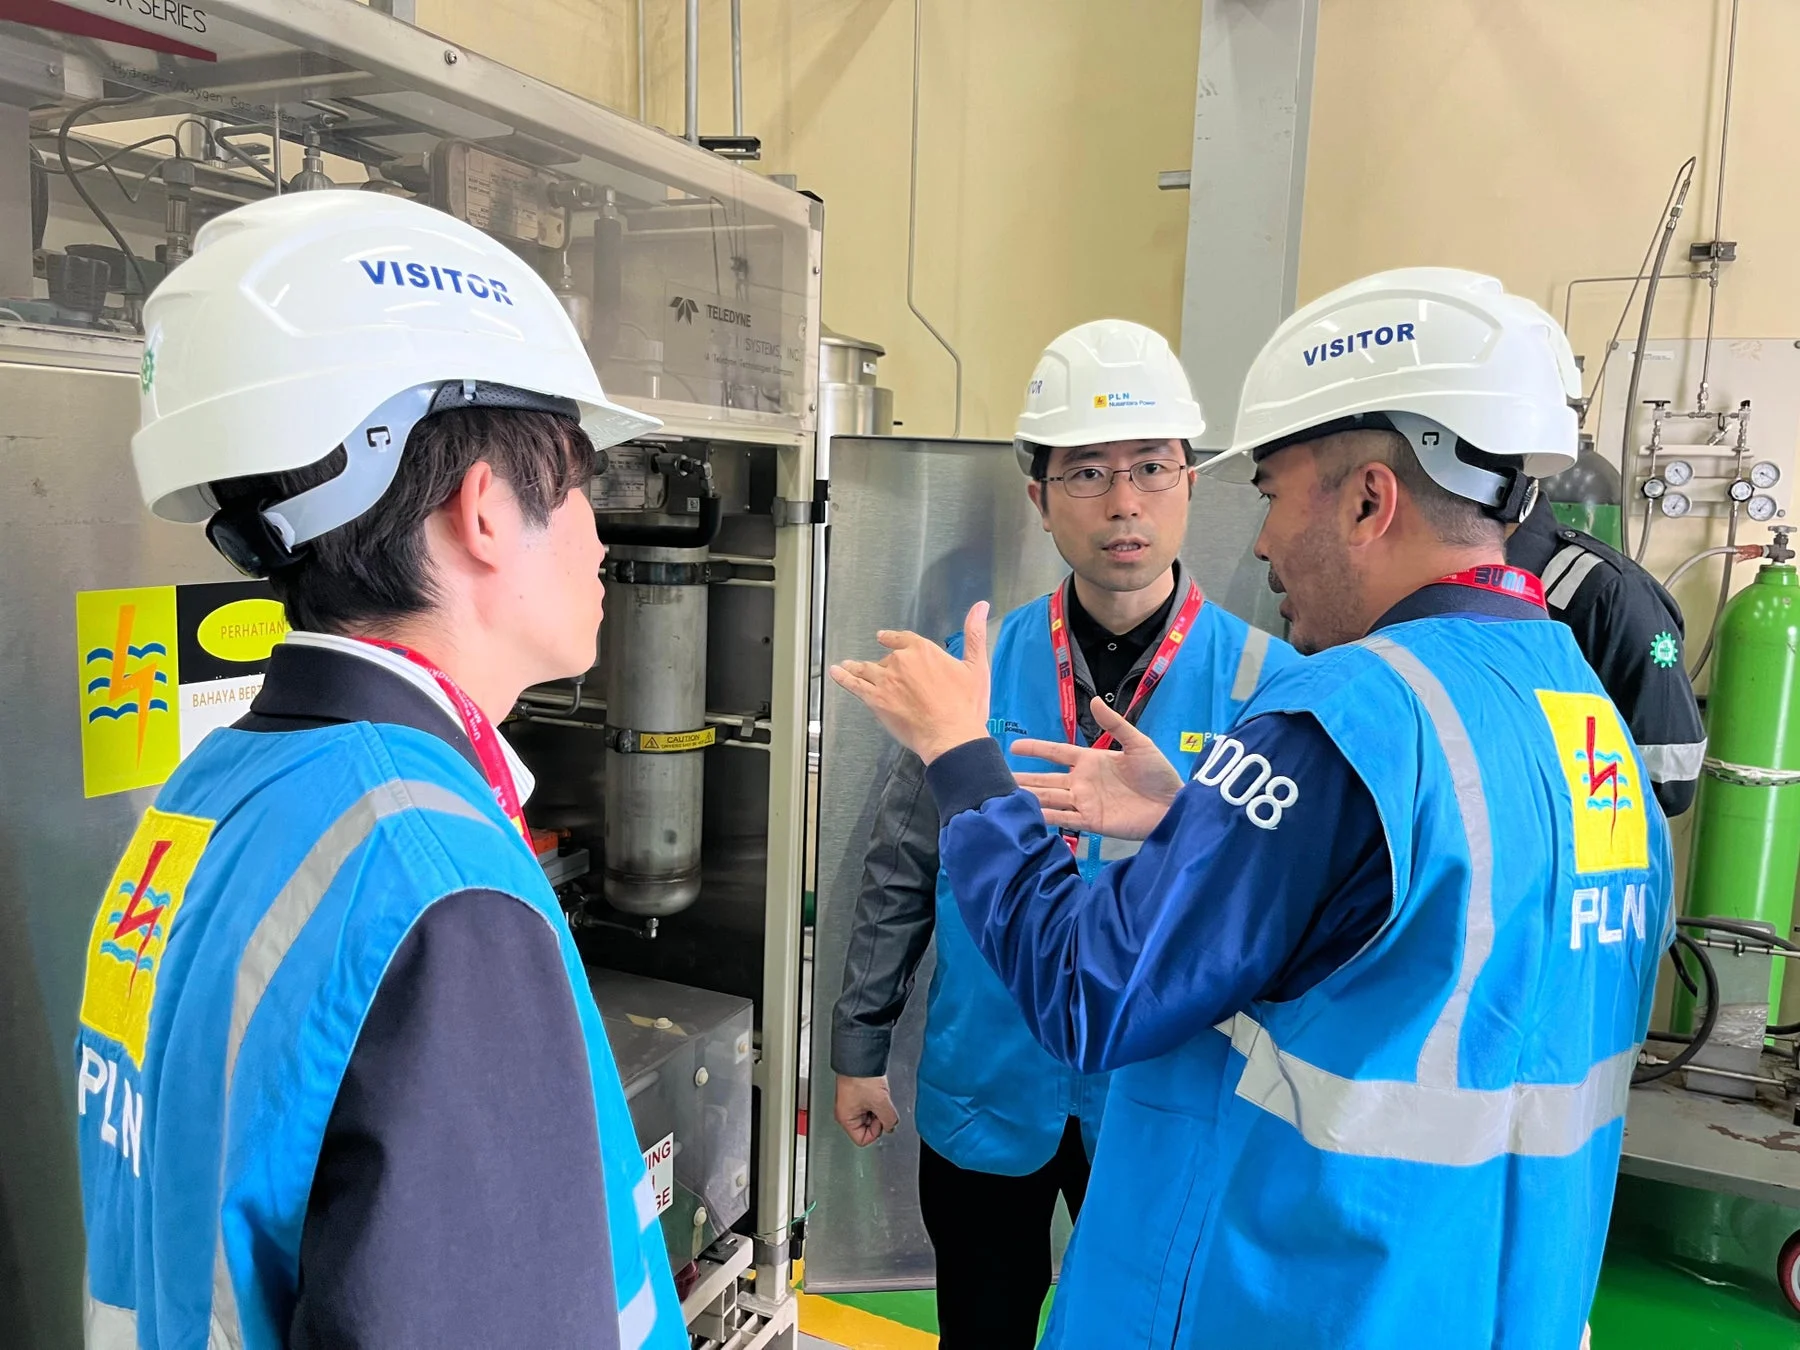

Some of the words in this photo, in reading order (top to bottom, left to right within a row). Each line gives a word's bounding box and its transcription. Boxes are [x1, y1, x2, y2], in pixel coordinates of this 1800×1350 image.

[138, 0, 207, 33] SERIES
[359, 260, 514, 306] VISITOR
[706, 304, 752, 328] TELEDYNE
[1303, 323, 1416, 367] VISITOR
[1108, 392, 1130, 401] PLN
[220, 621, 285, 640] PERHATIAN
[192, 689, 236, 708] BAHAYA
[667, 734, 700, 744] CAUTION
[1570, 883, 1647, 950] PLN
[78, 1043, 143, 1178] PLN
